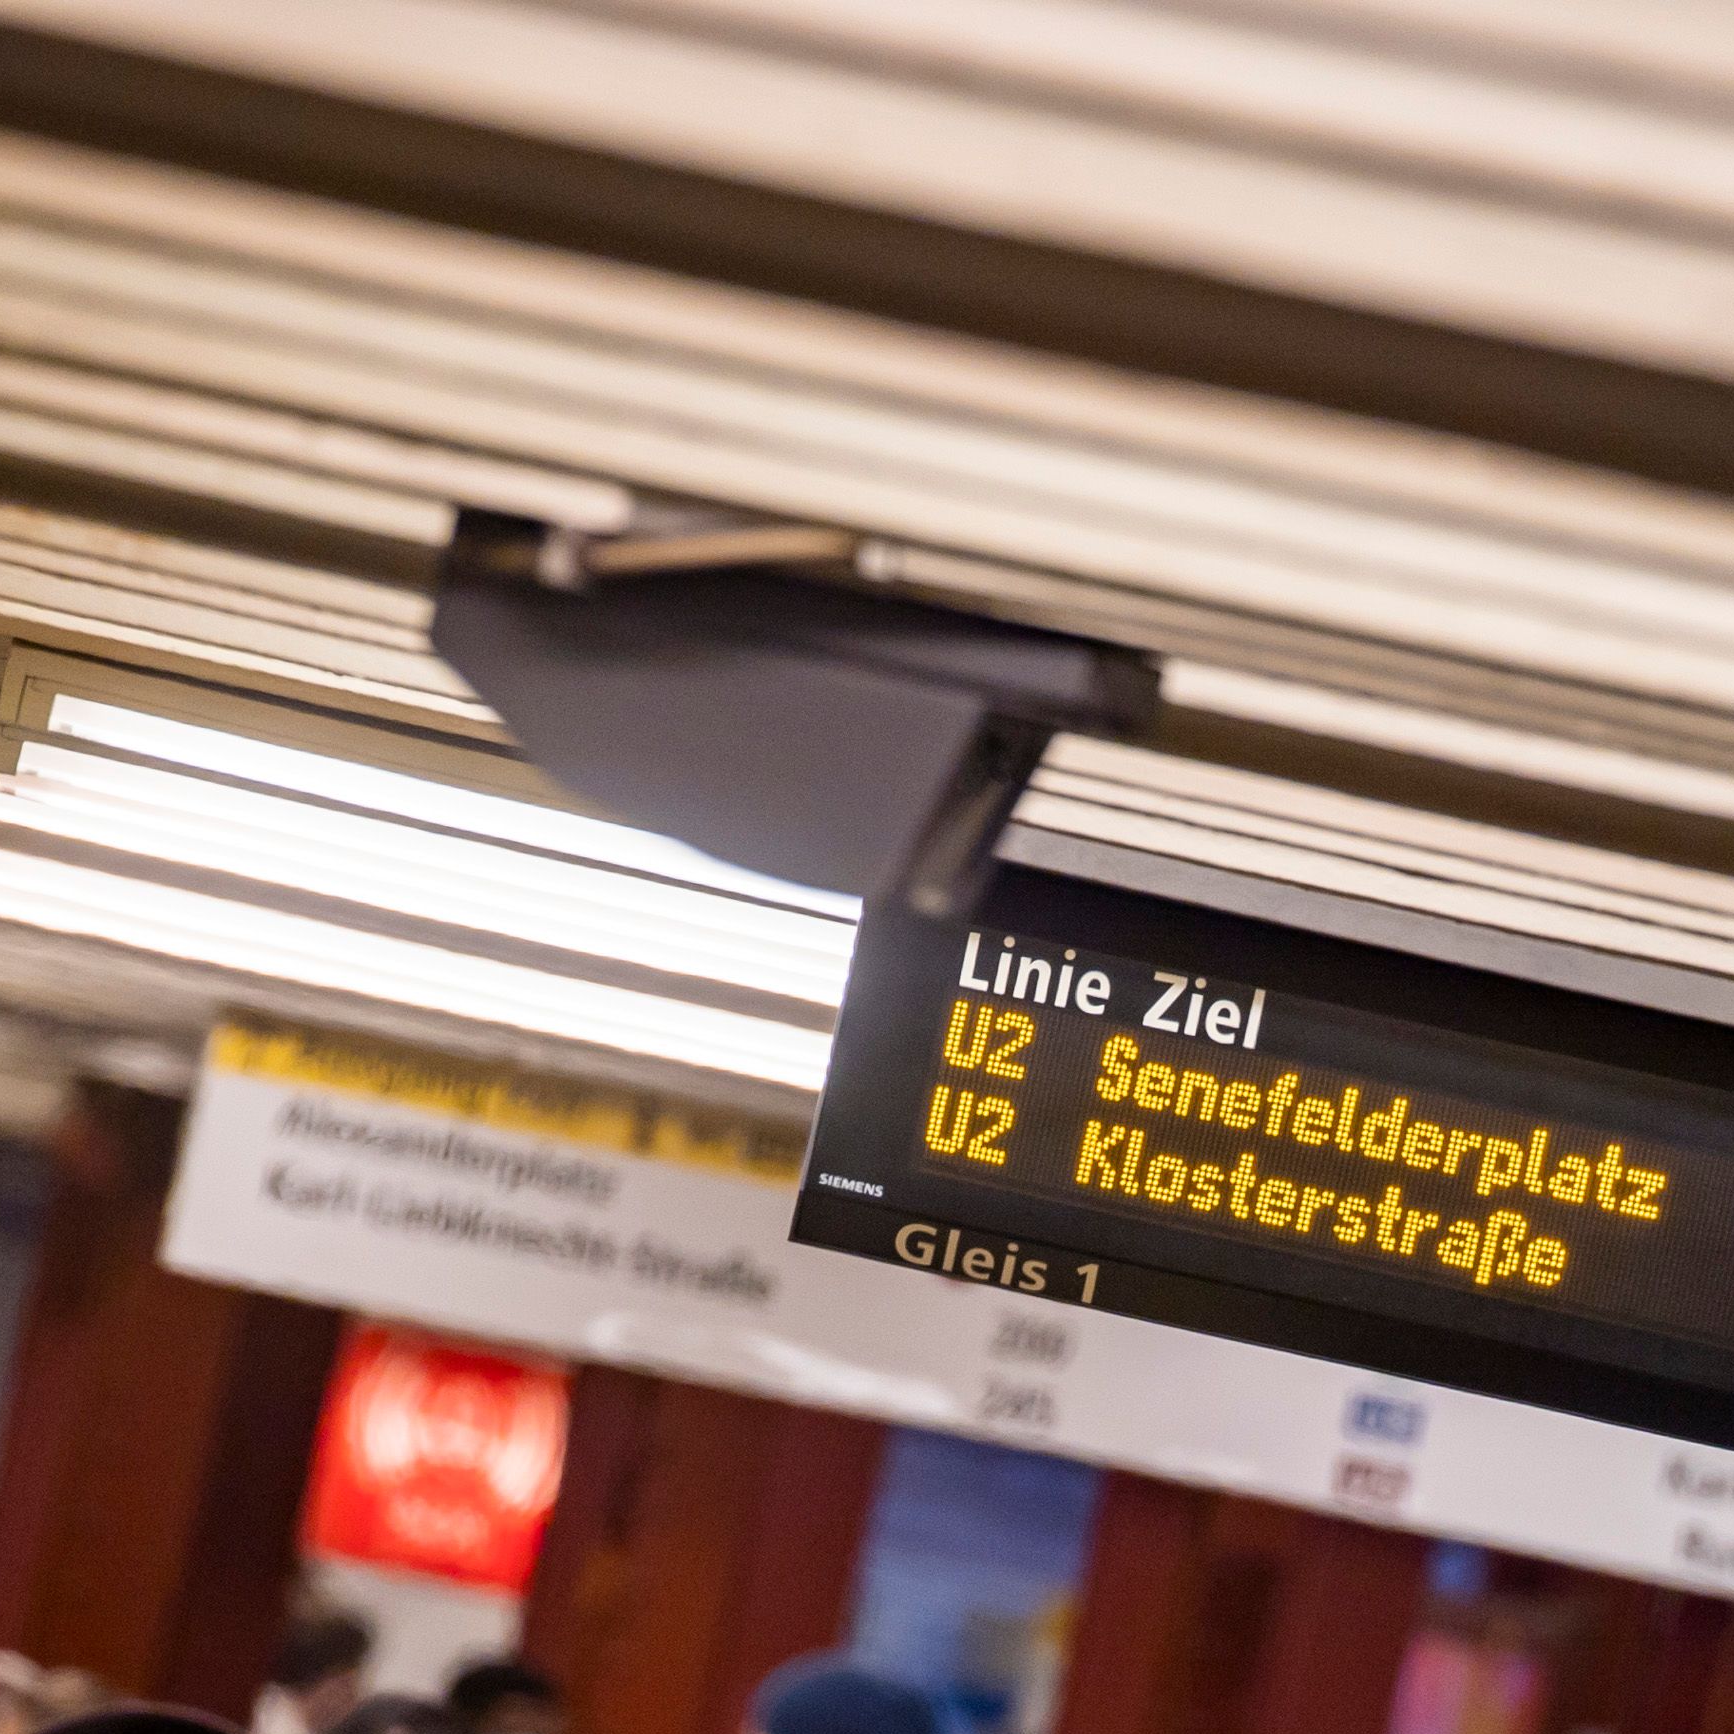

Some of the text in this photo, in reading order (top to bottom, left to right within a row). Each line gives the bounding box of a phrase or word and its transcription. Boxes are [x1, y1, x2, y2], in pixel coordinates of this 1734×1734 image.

[958, 932, 1265, 1049] Linie Ziel
[944, 1001, 1666, 1220] U2 Senefelderplatz
[819, 1172, 884, 1197] SIEMENS
[925, 1086, 1017, 1166] U2
[1075, 1119, 1567, 1288] Klosterstraße
[894, 1223, 1101, 1304] Gleis 1
